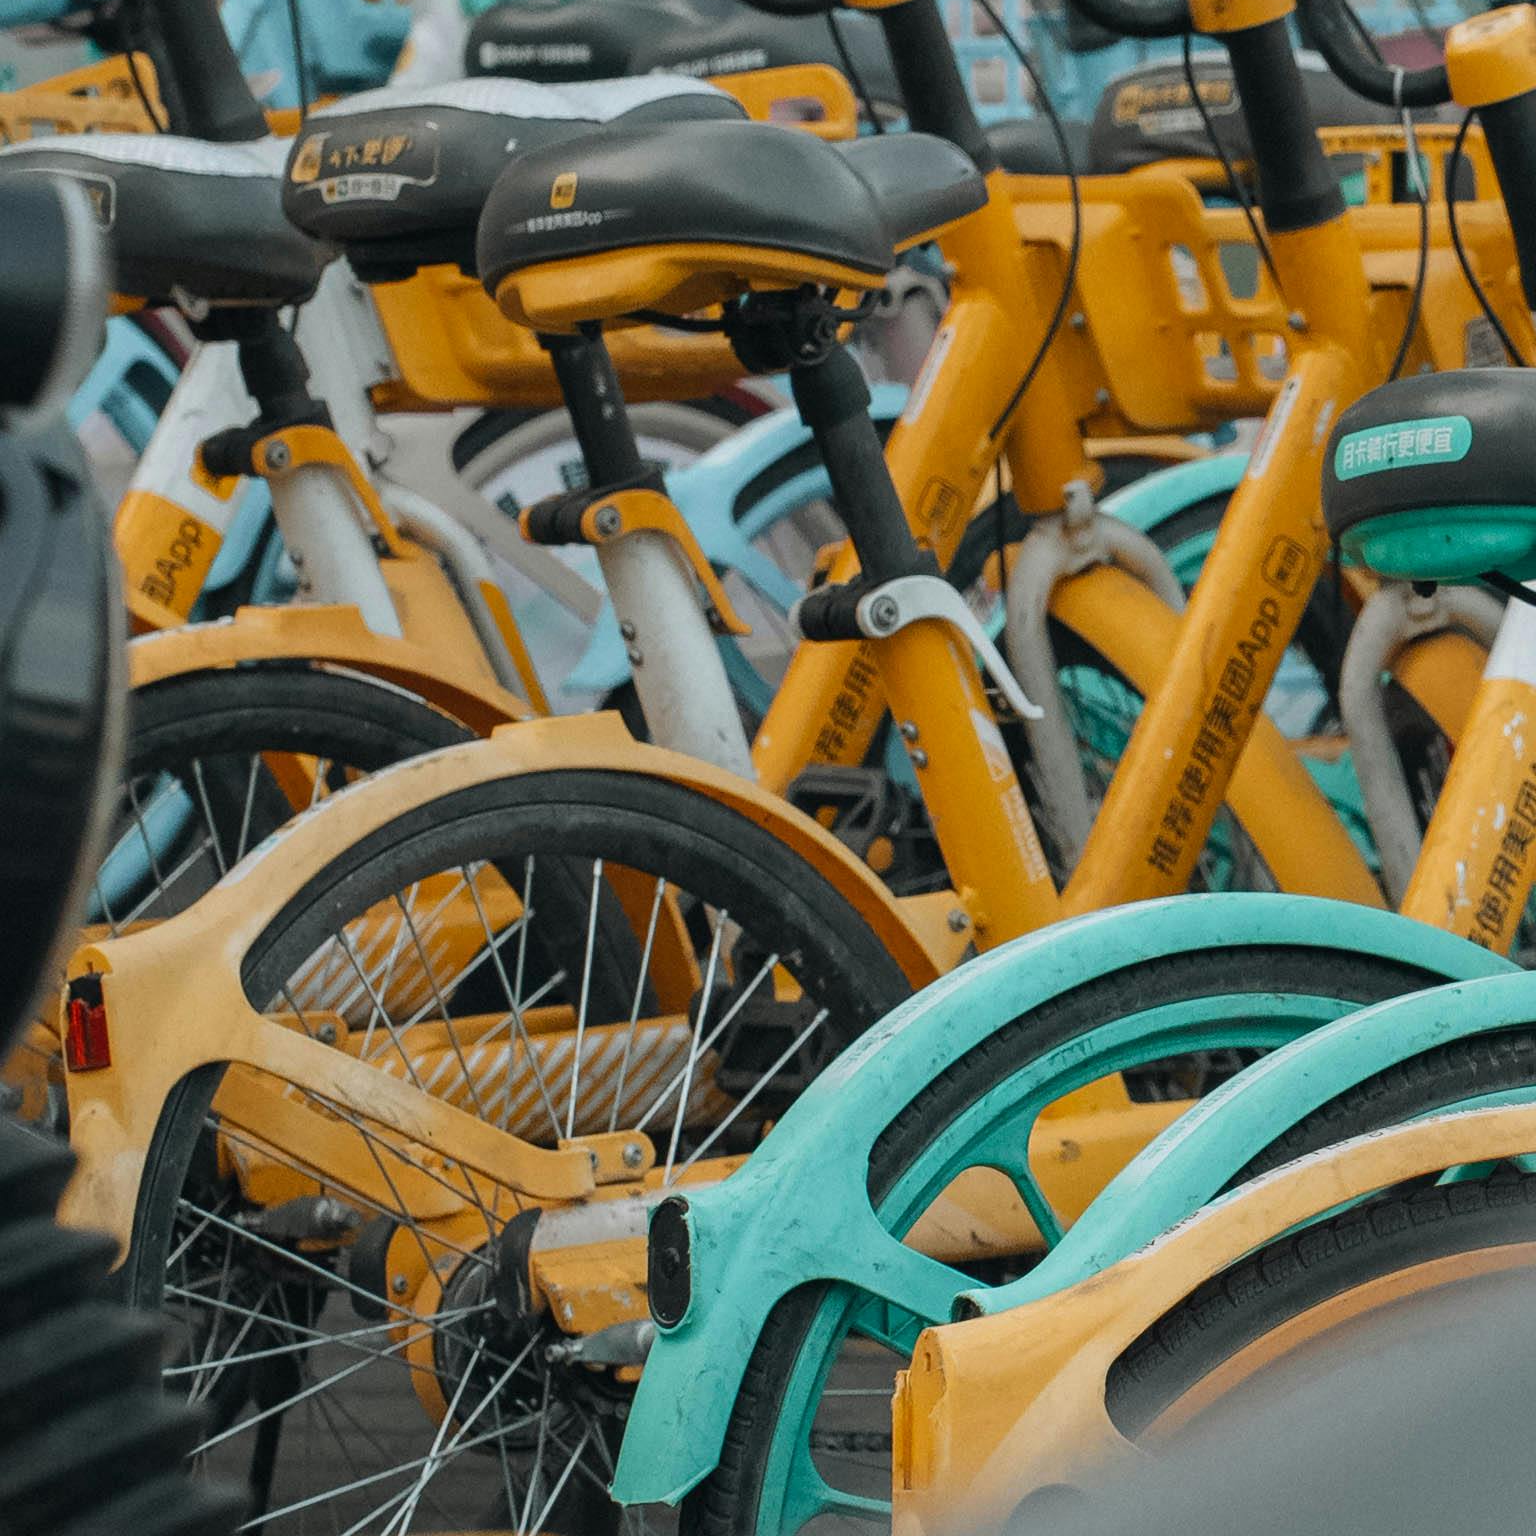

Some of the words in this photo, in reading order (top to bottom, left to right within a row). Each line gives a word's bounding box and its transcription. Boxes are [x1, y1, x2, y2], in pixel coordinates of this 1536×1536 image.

[1343, 426, 1453, 471] 月卡骑行更便宜
[814, 641, 879, 762] 荐使用
[1147, 596, 1281, 877] 推荐使用美团App
